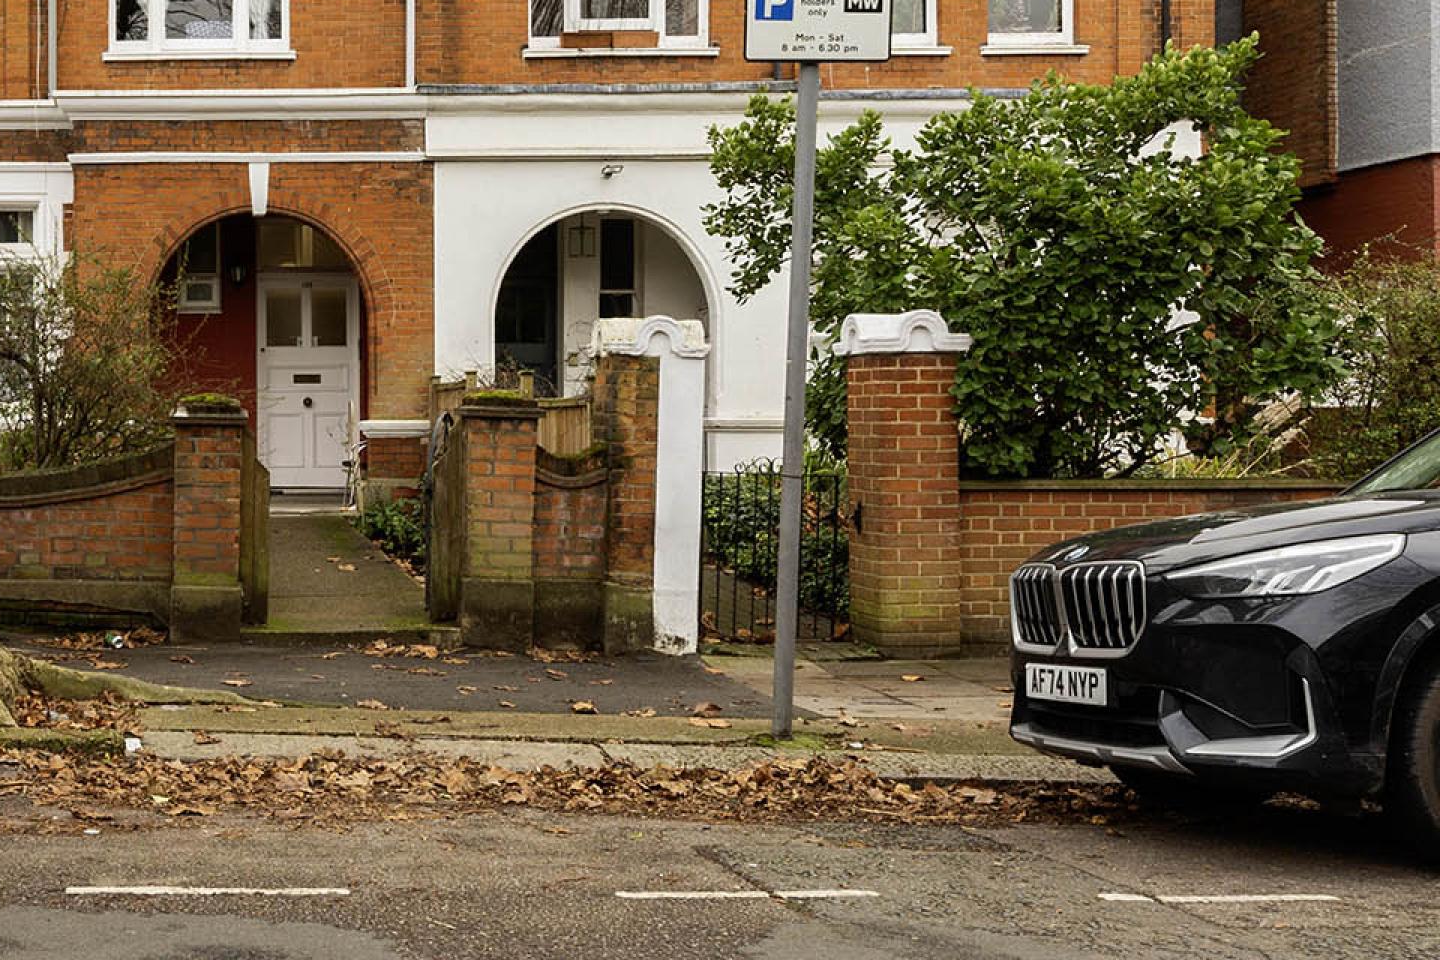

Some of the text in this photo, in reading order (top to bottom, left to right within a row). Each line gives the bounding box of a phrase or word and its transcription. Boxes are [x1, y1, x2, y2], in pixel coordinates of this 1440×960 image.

[808, 8, 828, 18] only
[795, 33, 815, 42] Mon
[828, 32, 844, 42] Sat
[781, 43, 788, 52] 8
[844, 45, 859, 53] pm
[1031, 667, 1099, 699] AF74 NYP
